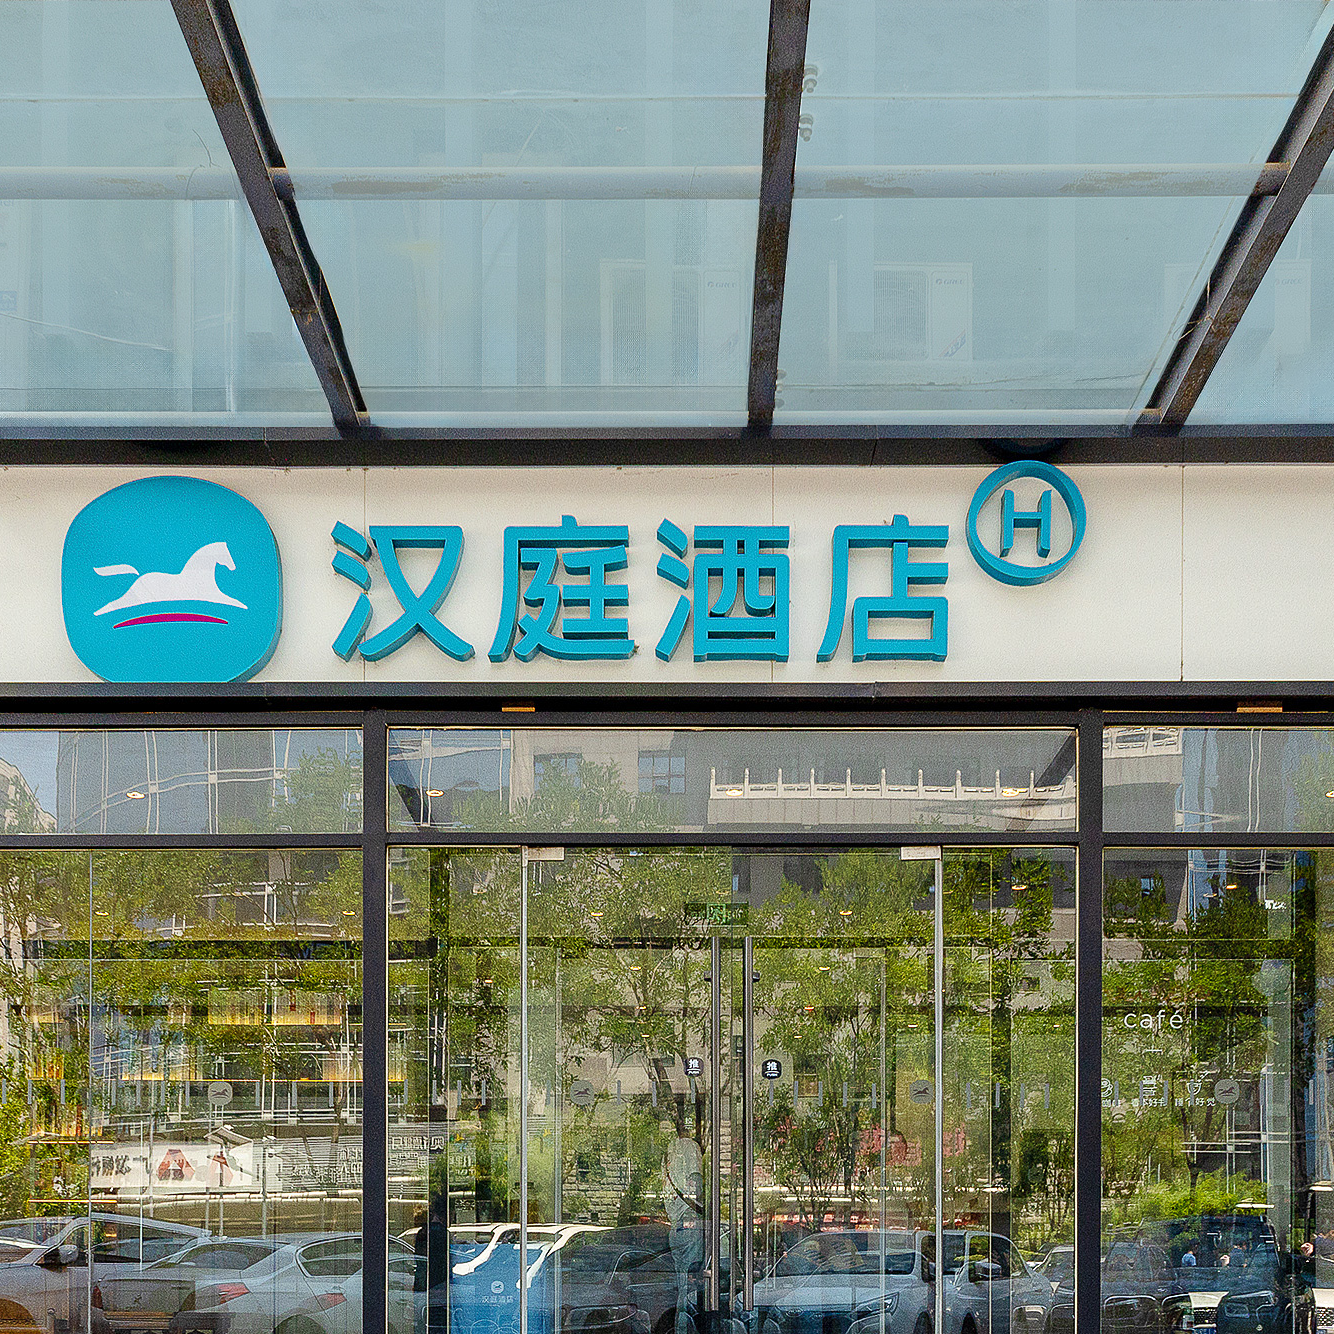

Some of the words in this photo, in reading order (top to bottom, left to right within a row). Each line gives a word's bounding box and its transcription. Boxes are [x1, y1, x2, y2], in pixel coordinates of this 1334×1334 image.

[1001, 490, 1052, 559] H
[331, 514, 950, 663] 汉庭酒店
[1123, 1009, 1184, 1029] café
[689, 1060, 699, 1068] 推
[767, 1062, 777, 1071] 推
